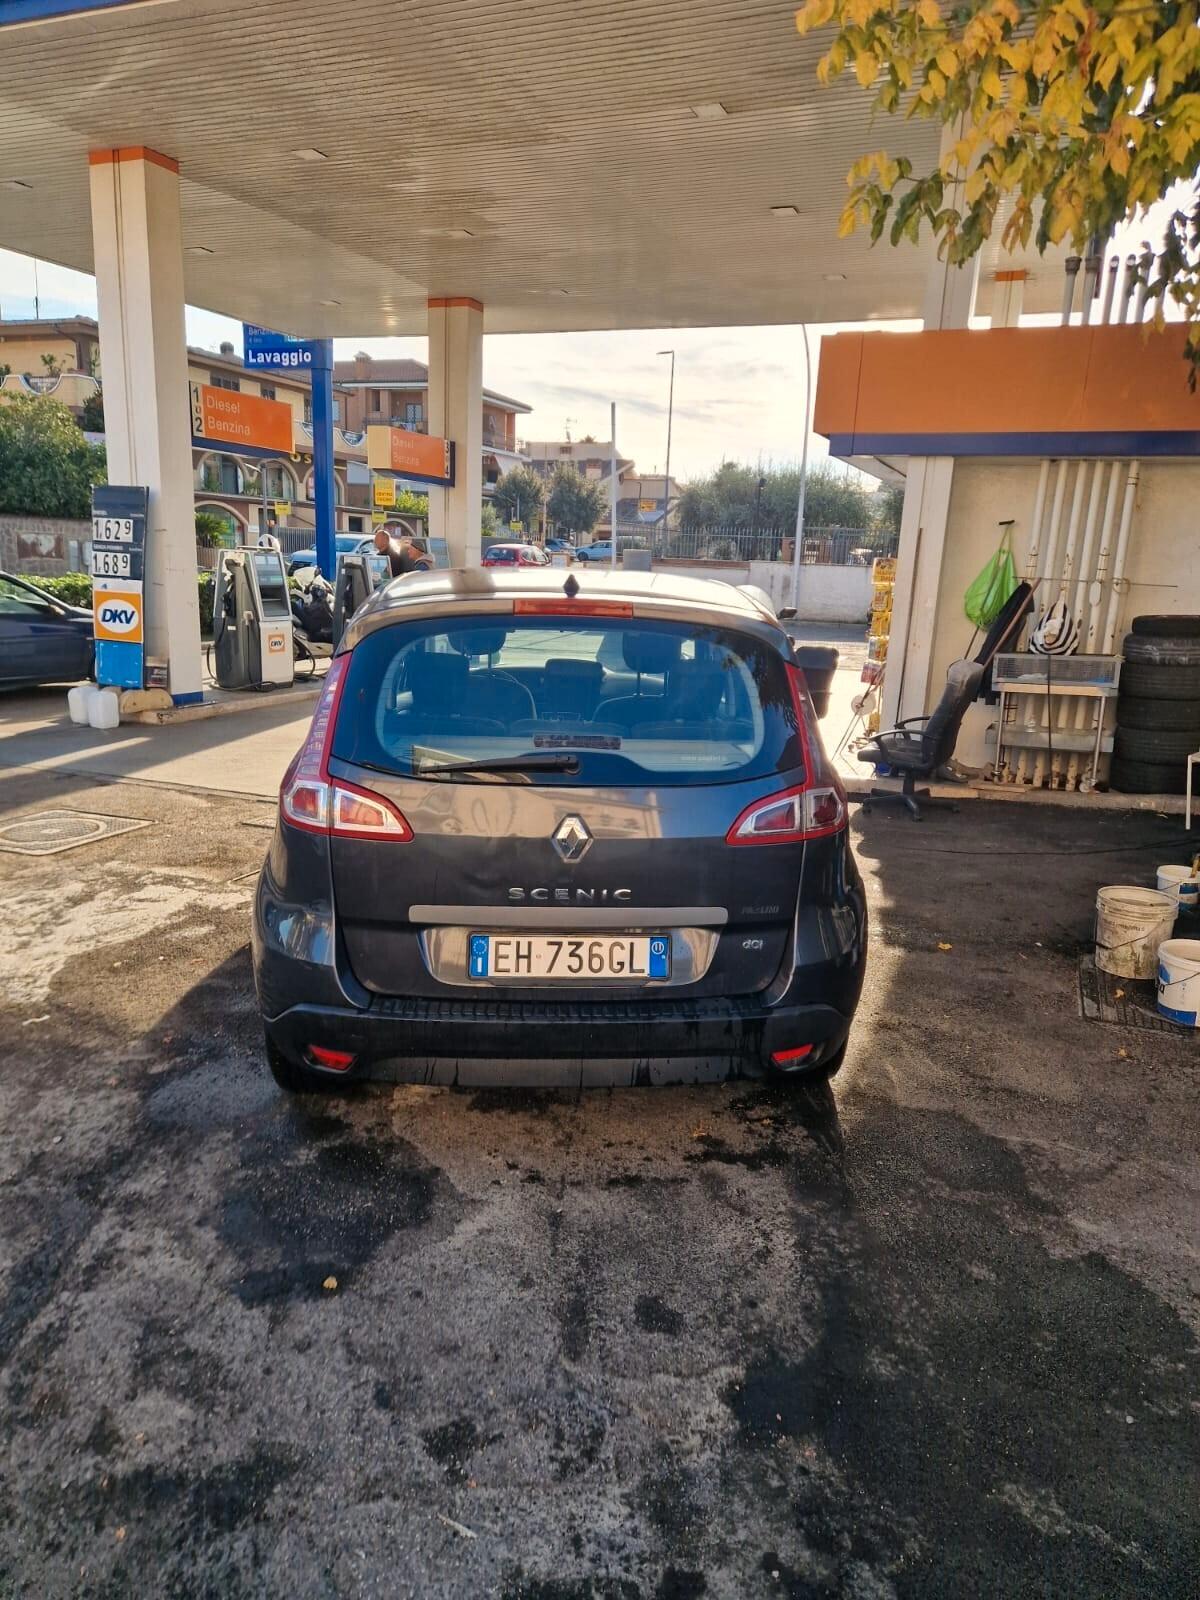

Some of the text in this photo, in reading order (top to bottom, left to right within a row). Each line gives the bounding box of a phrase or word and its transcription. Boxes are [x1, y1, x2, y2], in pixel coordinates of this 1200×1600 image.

[248, 349, 312, 366] Lavaggio
[192, 387, 199, 403] 1
[206, 395, 240, 414] Diesel
[195, 417, 203, 433] 2
[207, 416, 250, 436] Benzina
[101, 608, 136, 625] DKV
[507, 887, 633, 901] SCENIC
[742, 939, 764, 950] dCi
[493, 940, 645, 975] EH 736GL
